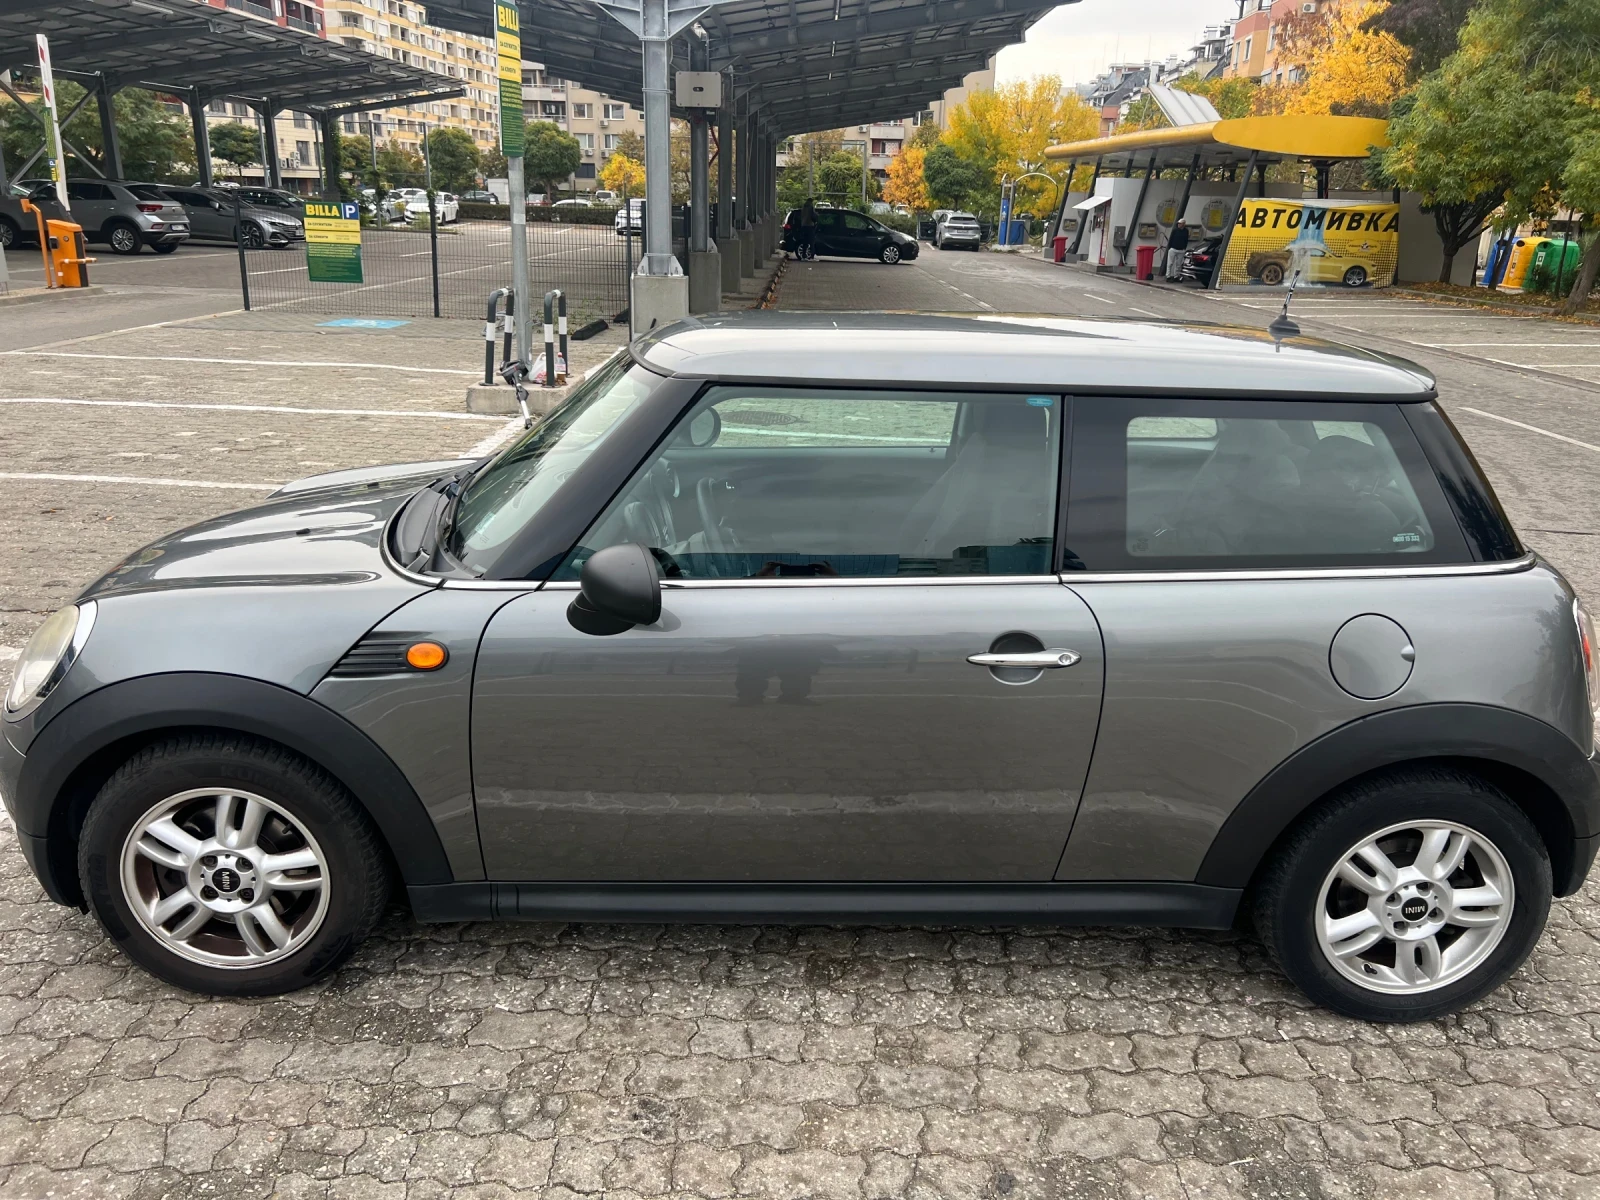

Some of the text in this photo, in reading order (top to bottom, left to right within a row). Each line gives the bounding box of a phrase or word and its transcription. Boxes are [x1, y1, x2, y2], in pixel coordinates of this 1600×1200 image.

[305, 204, 356, 218] BILLA P
[1235, 208, 1399, 232] АВТОМИВКА
[221, 871, 231, 890] MINI
[1405, 905, 1425, 914] MINI
